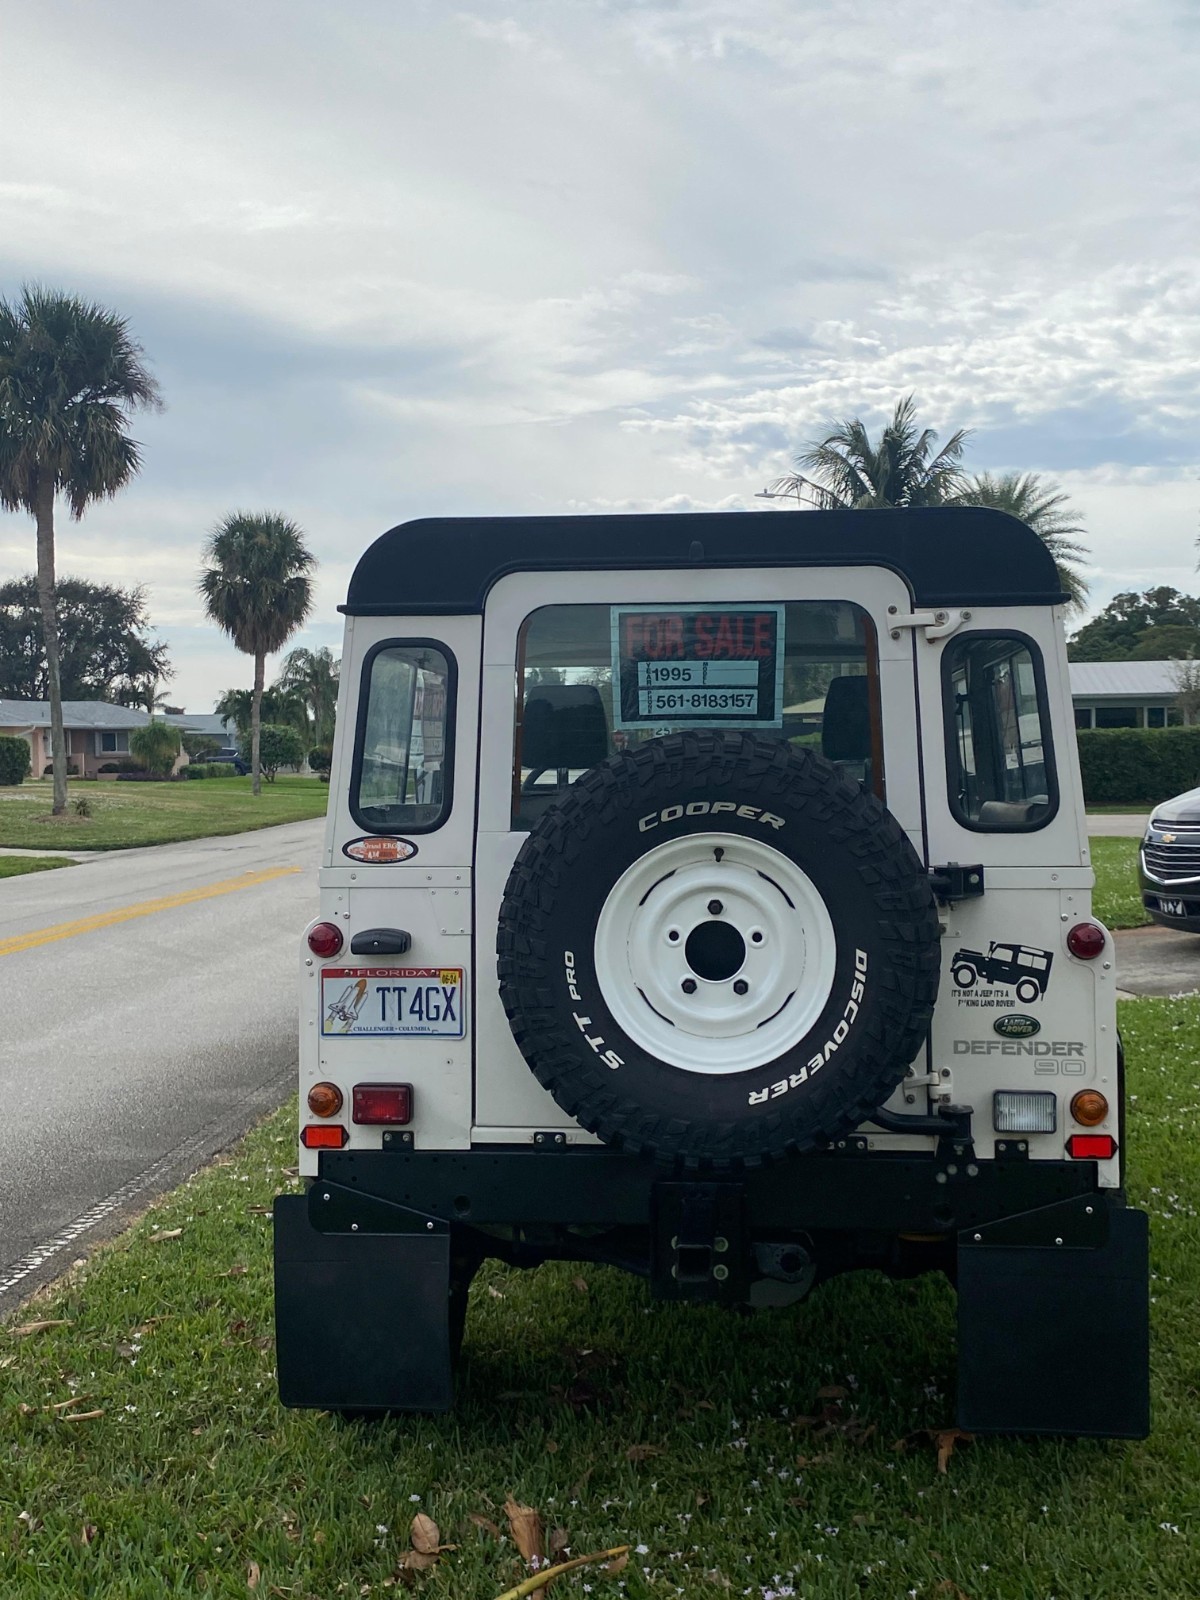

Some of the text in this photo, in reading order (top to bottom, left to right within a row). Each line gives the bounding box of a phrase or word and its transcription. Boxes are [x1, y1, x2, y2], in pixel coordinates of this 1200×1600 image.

[626, 614, 772, 658] FOR SALE
[652, 667, 692, 681] 1995
[638, 802, 786, 832] COOPER
[357, 969, 428, 977] FLORIDA
[564, 950, 582, 1001] PRO
[962, 989, 974, 998] NOT
[974, 989, 979, 998] A
[979, 989, 993, 998] JEEP
[1004, 989, 1009, 998] A
[376, 986, 457, 1022] TT4GX
[980, 999, 995, 1008] LAND
[748, 948, 869, 1106] DISCOVERER
[1003, 1018, 1026, 1026] LAND
[1005, 1025, 1033, 1033] ROVER
[953, 1040, 1085, 1057] DEFENDER
[1034, 1058, 1086, 1077] 90
